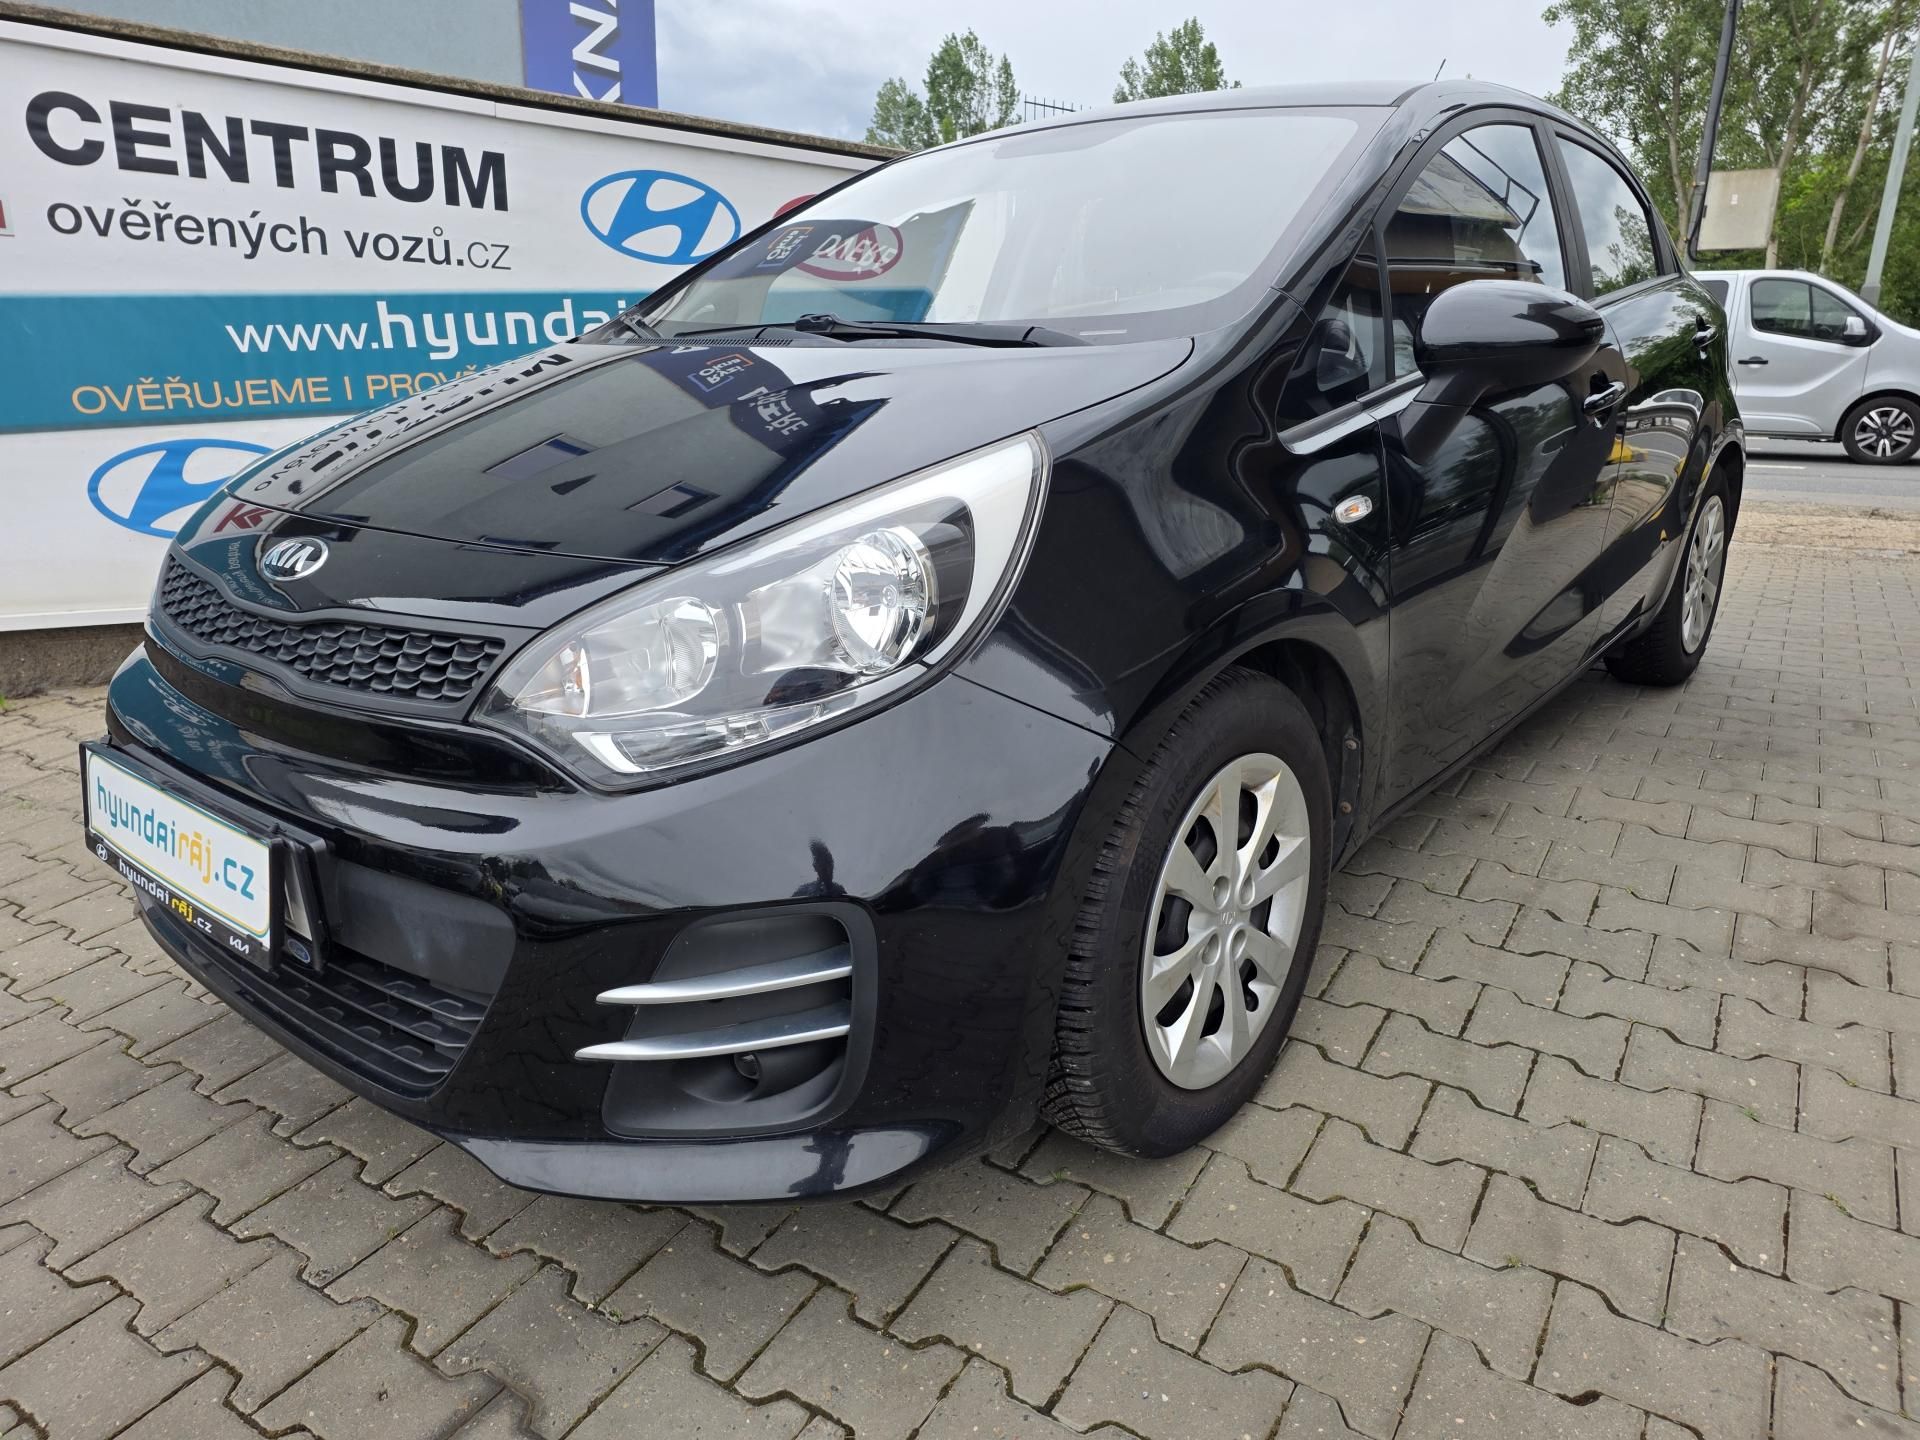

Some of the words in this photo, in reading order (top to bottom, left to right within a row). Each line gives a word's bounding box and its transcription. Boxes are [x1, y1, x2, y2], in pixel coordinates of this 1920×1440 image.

[569, 0, 621, 103] KN
[25, 90, 509, 213] CENTRUM
[46, 198, 328, 260] ověřených
[344, 226, 512, 271] vozů.cz
[71, 376, 331, 415] OVĚŘUJEME
